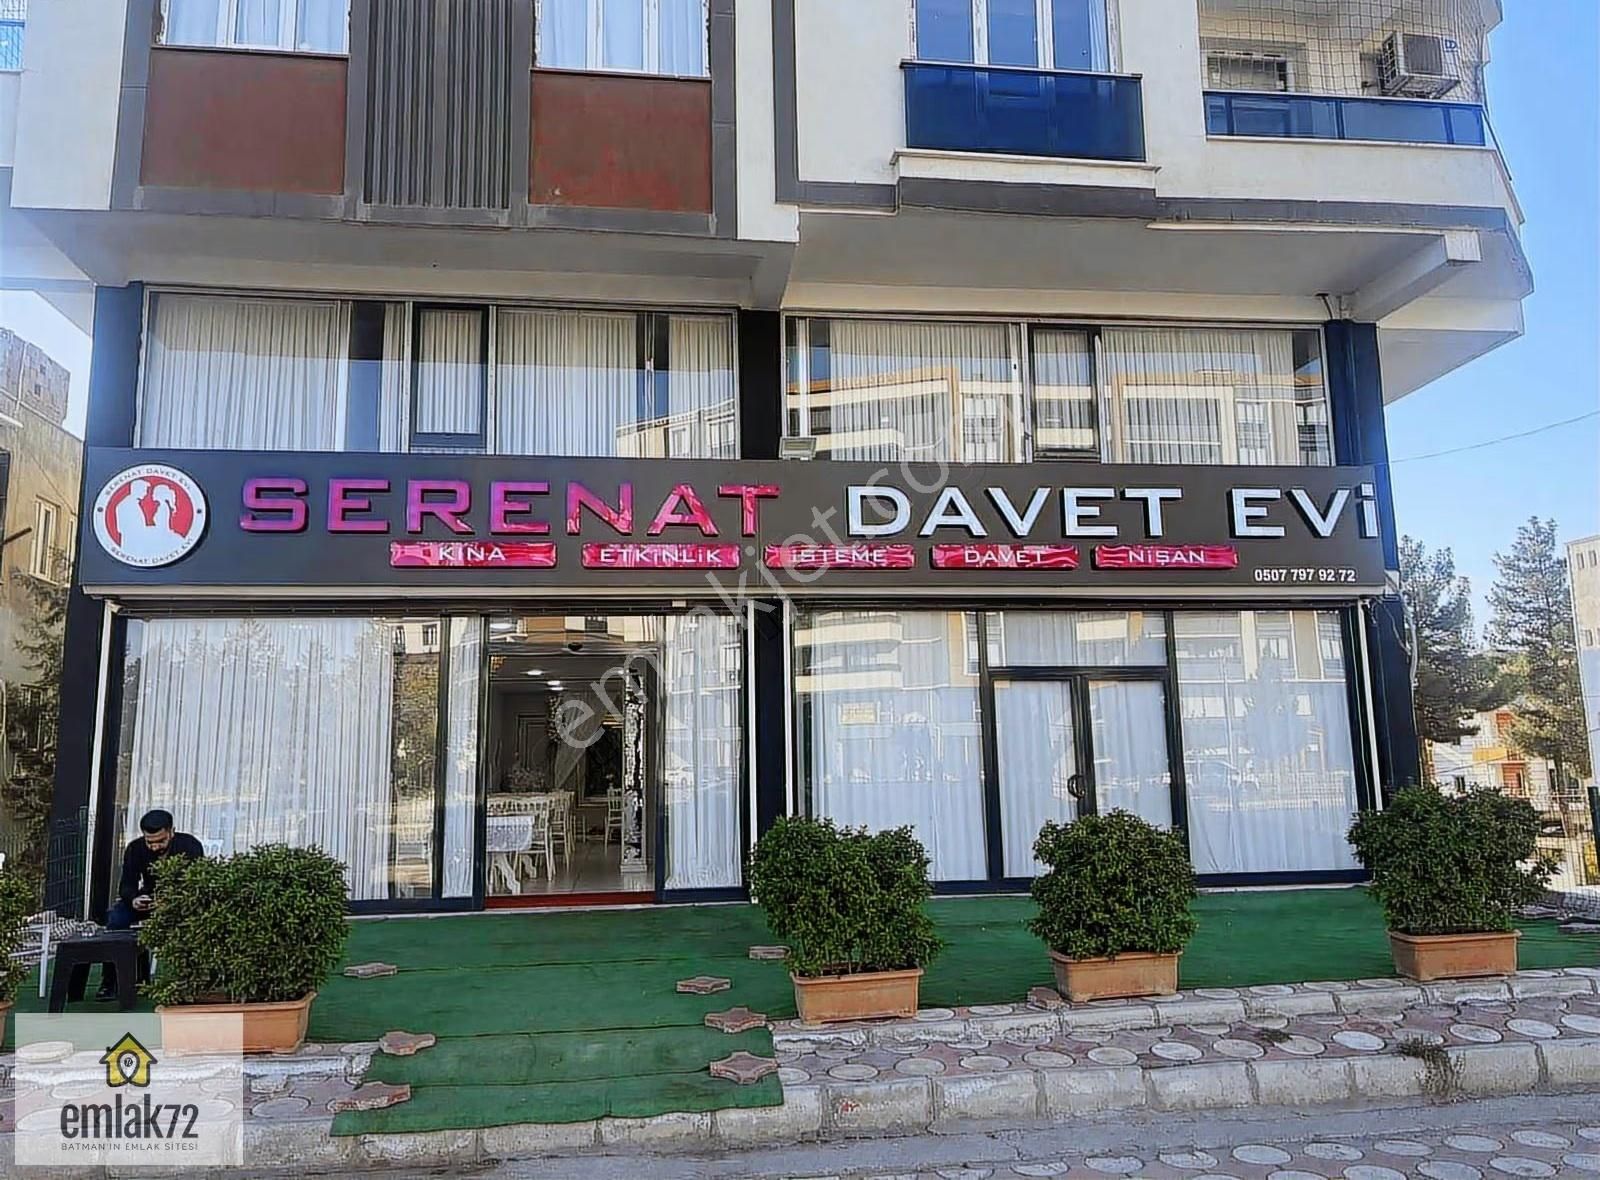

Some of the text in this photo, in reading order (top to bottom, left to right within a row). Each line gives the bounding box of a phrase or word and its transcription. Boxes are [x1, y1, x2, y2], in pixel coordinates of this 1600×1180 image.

[239, 476, 782, 537] SERENAT
[846, 485, 1184, 537] DAVET
[437, 546, 507, 562] KINA
[964, 550, 1042, 563] DAVET
[1254, 568, 1356, 582] 0507 797 92 72
